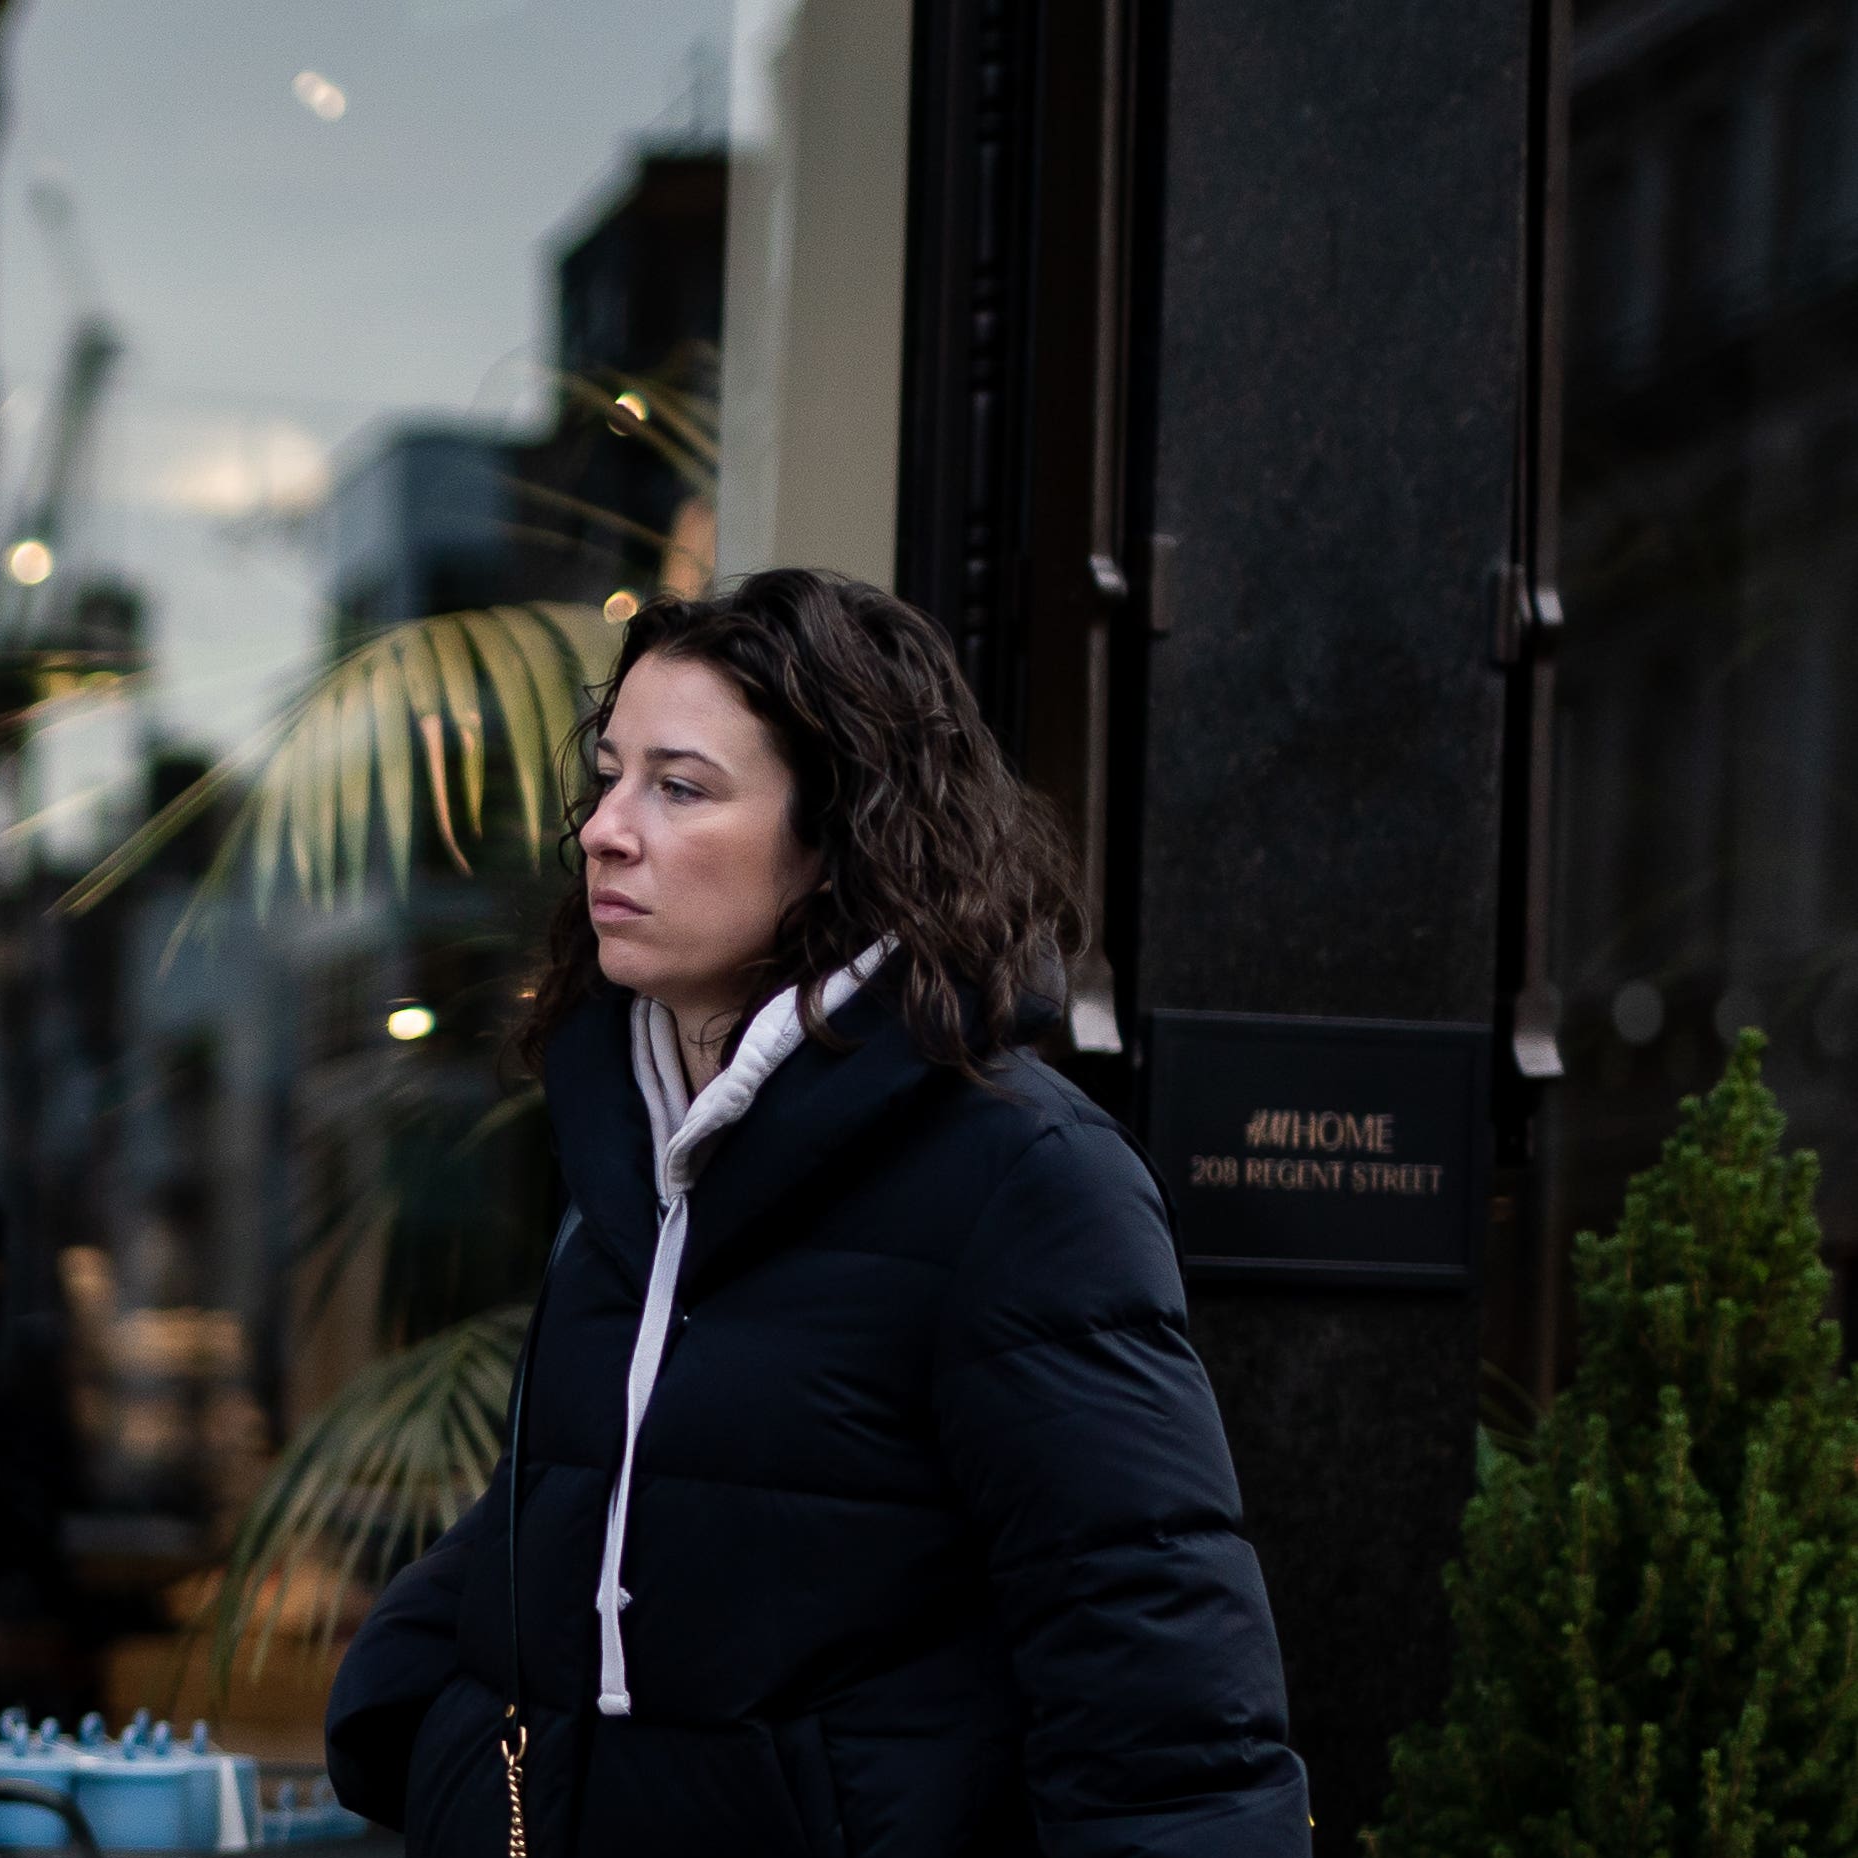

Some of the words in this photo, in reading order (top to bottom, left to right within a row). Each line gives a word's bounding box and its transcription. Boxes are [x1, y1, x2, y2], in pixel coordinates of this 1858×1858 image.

[1292, 1110, 1394, 1153] HOME
[1245, 1157, 1343, 1190] REGENT
[1350, 1161, 1444, 1194] STREET
